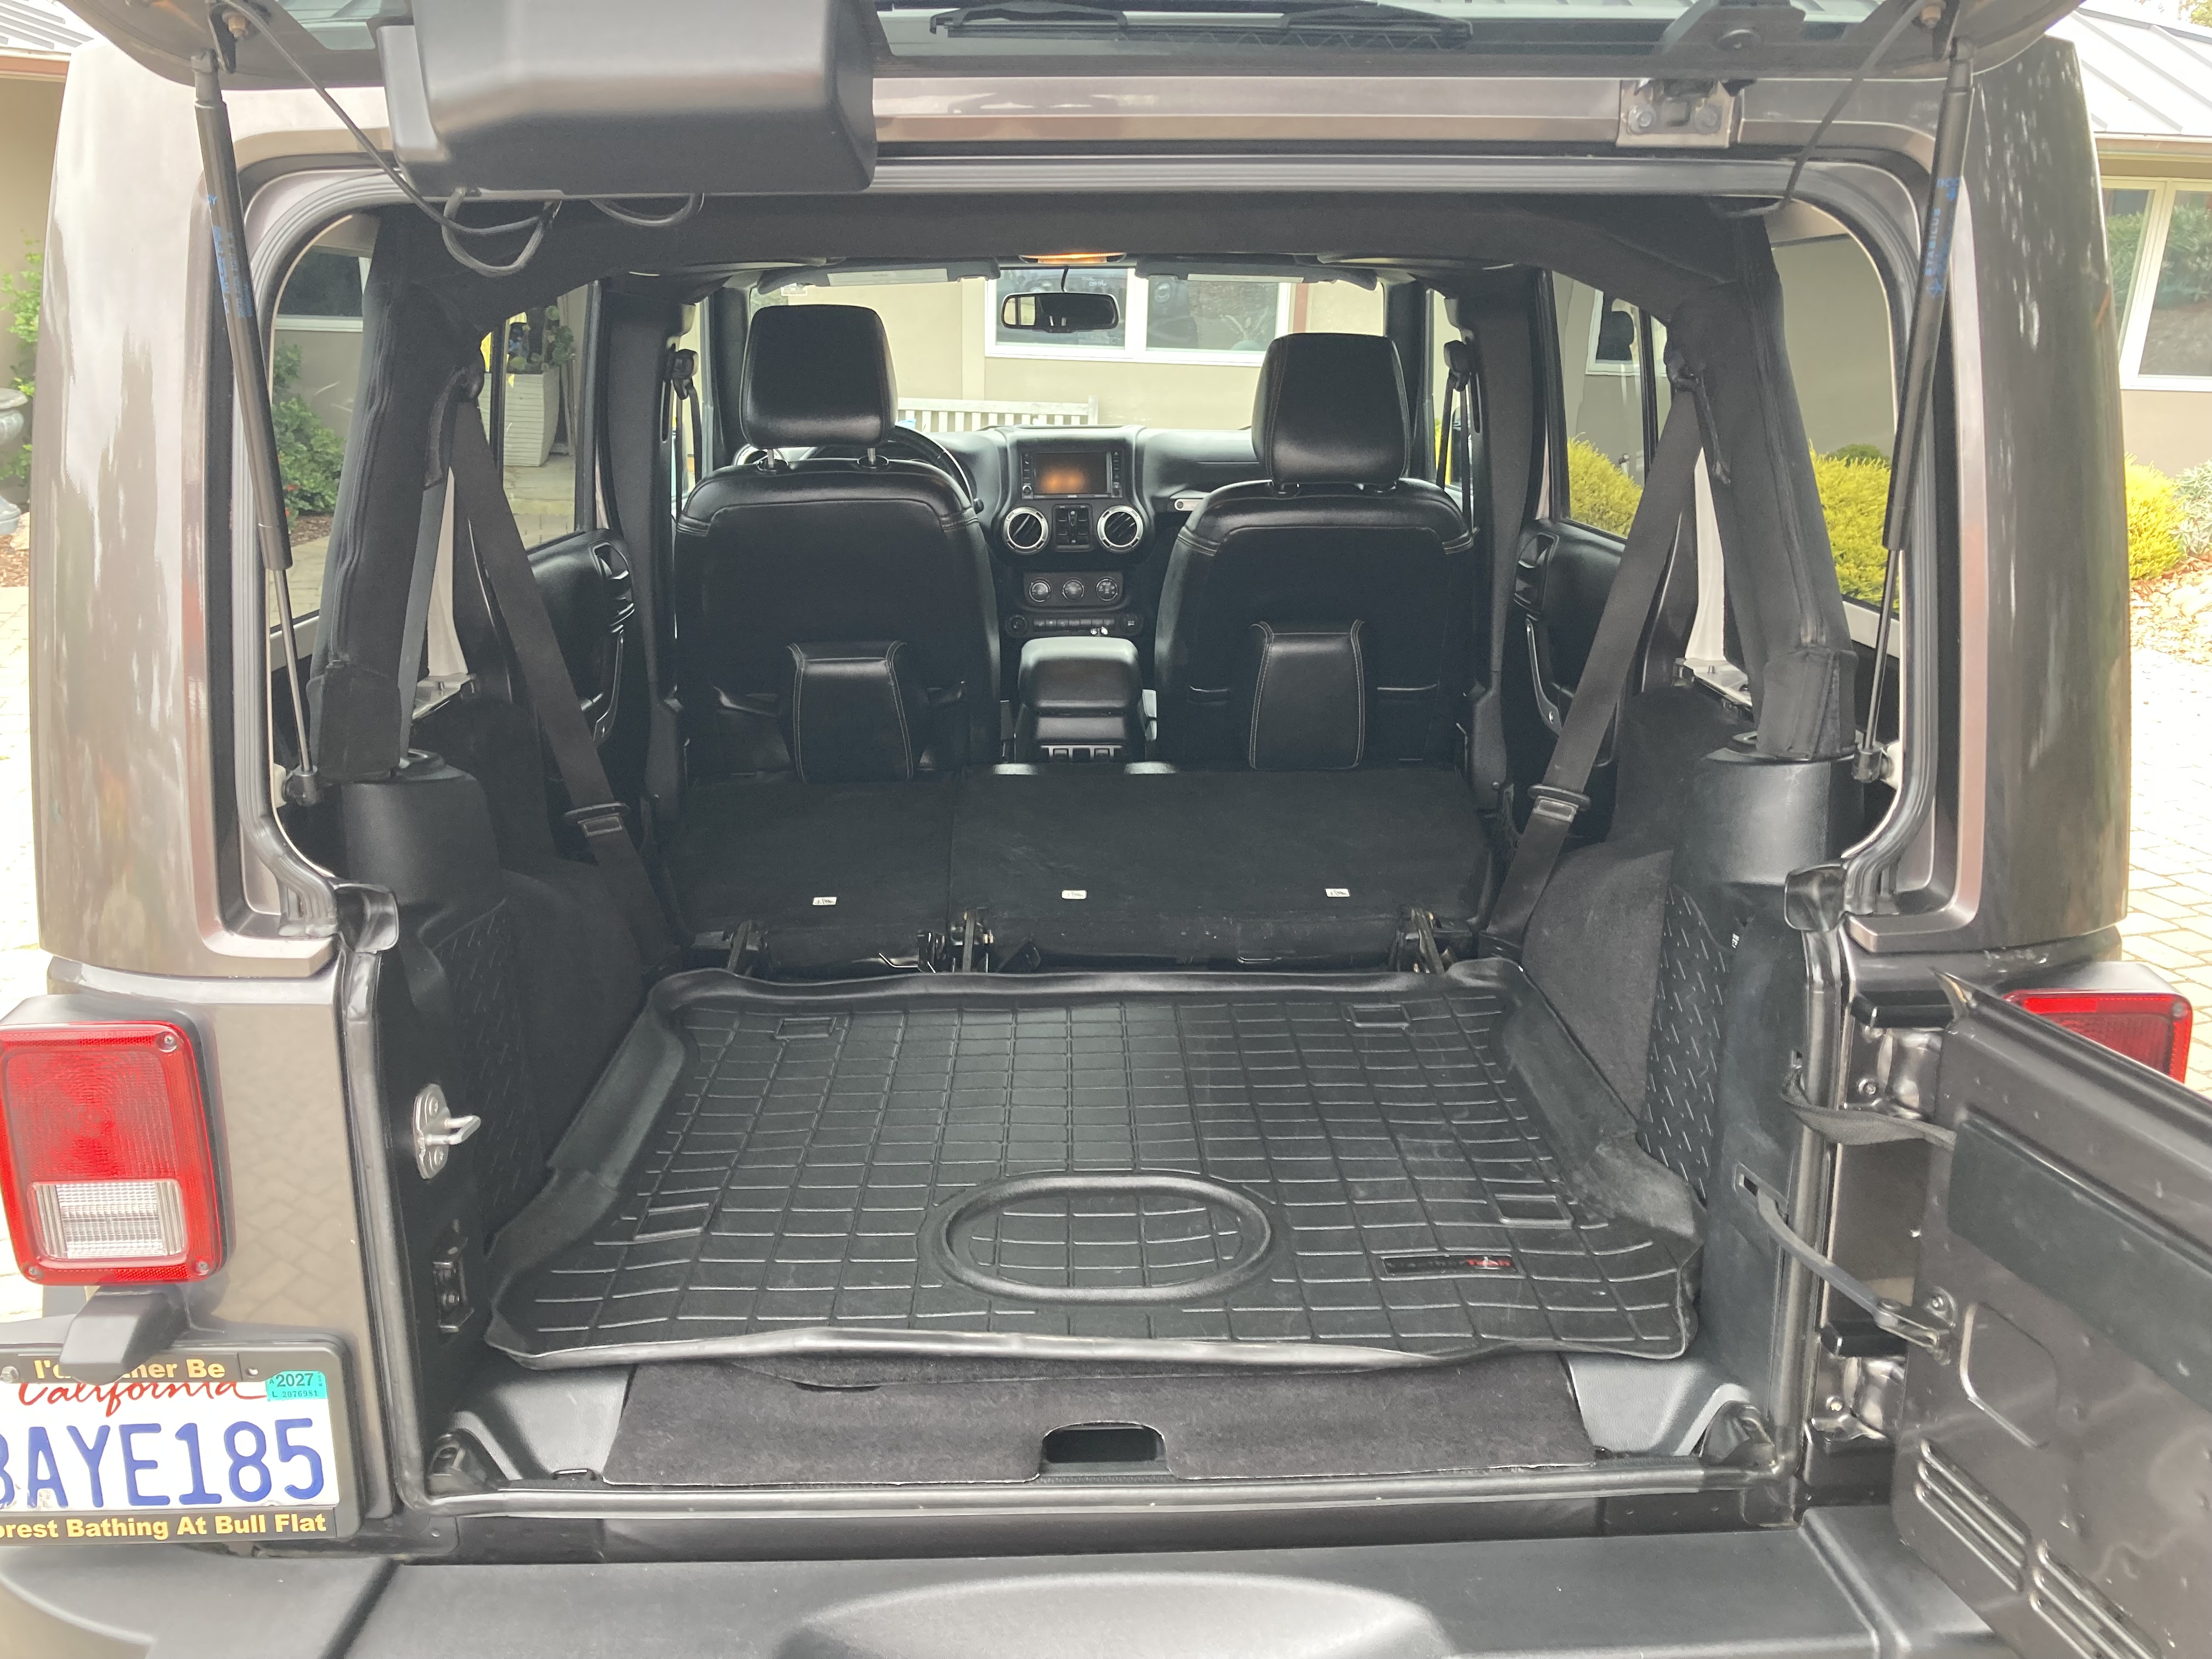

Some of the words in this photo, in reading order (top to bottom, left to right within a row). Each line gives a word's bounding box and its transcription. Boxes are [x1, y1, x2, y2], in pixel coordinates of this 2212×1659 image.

[186, 1359, 225, 1378] Be
[275, 1373, 313, 1387] 2027
[282, 1390, 318, 1398] 2076981
[65, 1517, 169, 1541] Bathing
[177, 1516, 207, 1535] At
[215, 1514, 267, 1534] Bull
[274, 1513, 327, 1532] Flat
